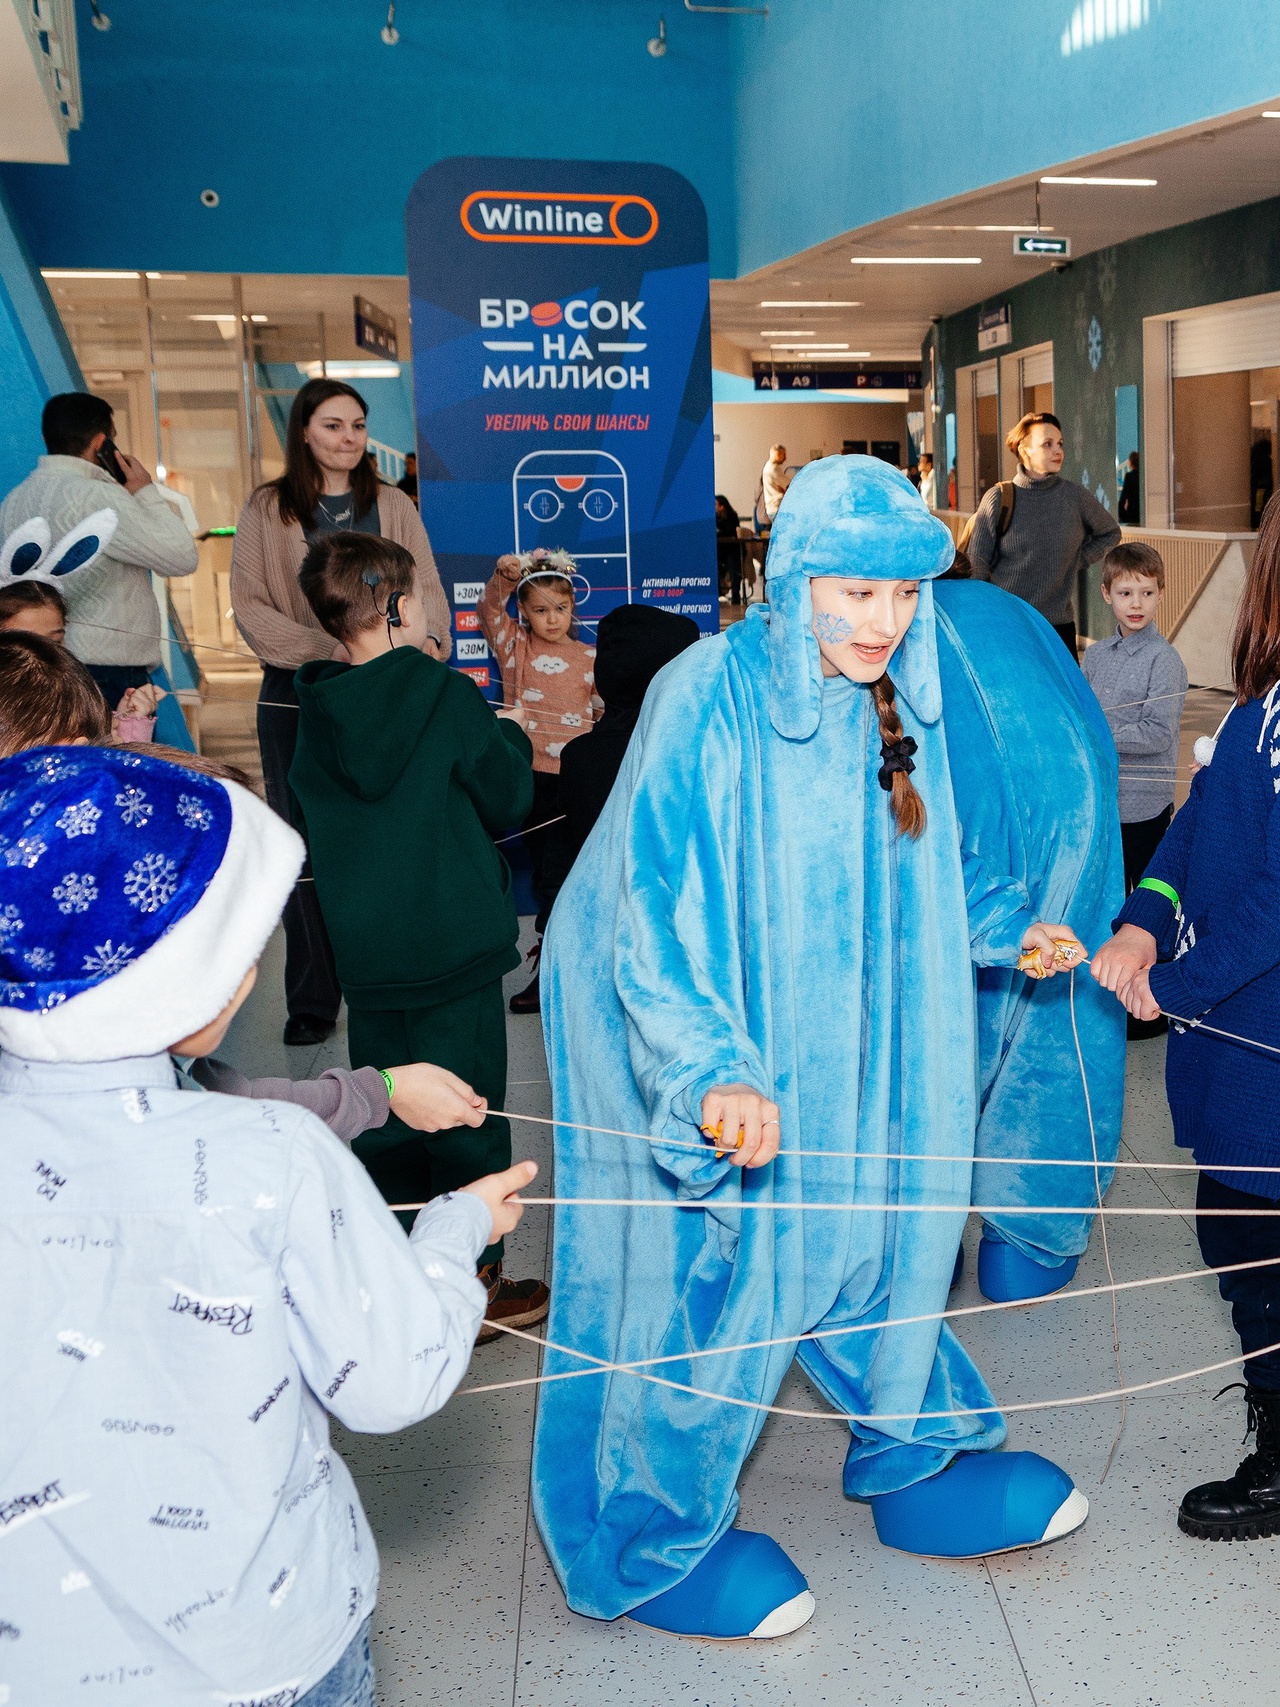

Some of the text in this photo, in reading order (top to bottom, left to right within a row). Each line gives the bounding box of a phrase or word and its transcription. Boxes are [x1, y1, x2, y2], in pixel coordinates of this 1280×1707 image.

[478, 202, 604, 232] Winline
[543, 334, 593, 360] НА
[482, 365, 649, 390] МИЛЛИОН
[484, 414, 650, 431] УВЕЛИЧЬ СВОИ ШАНСЫ
[642, 577, 711, 587] АКТИВНЫЙ ПРОГНОЗ
[642, 589, 652, 598] ОТ
[682, 604, 712, 614] ПРОГНОЗ
[168, 1293, 253, 1335] RESPECT
[0, 1478, 65, 1525] ESPECT
